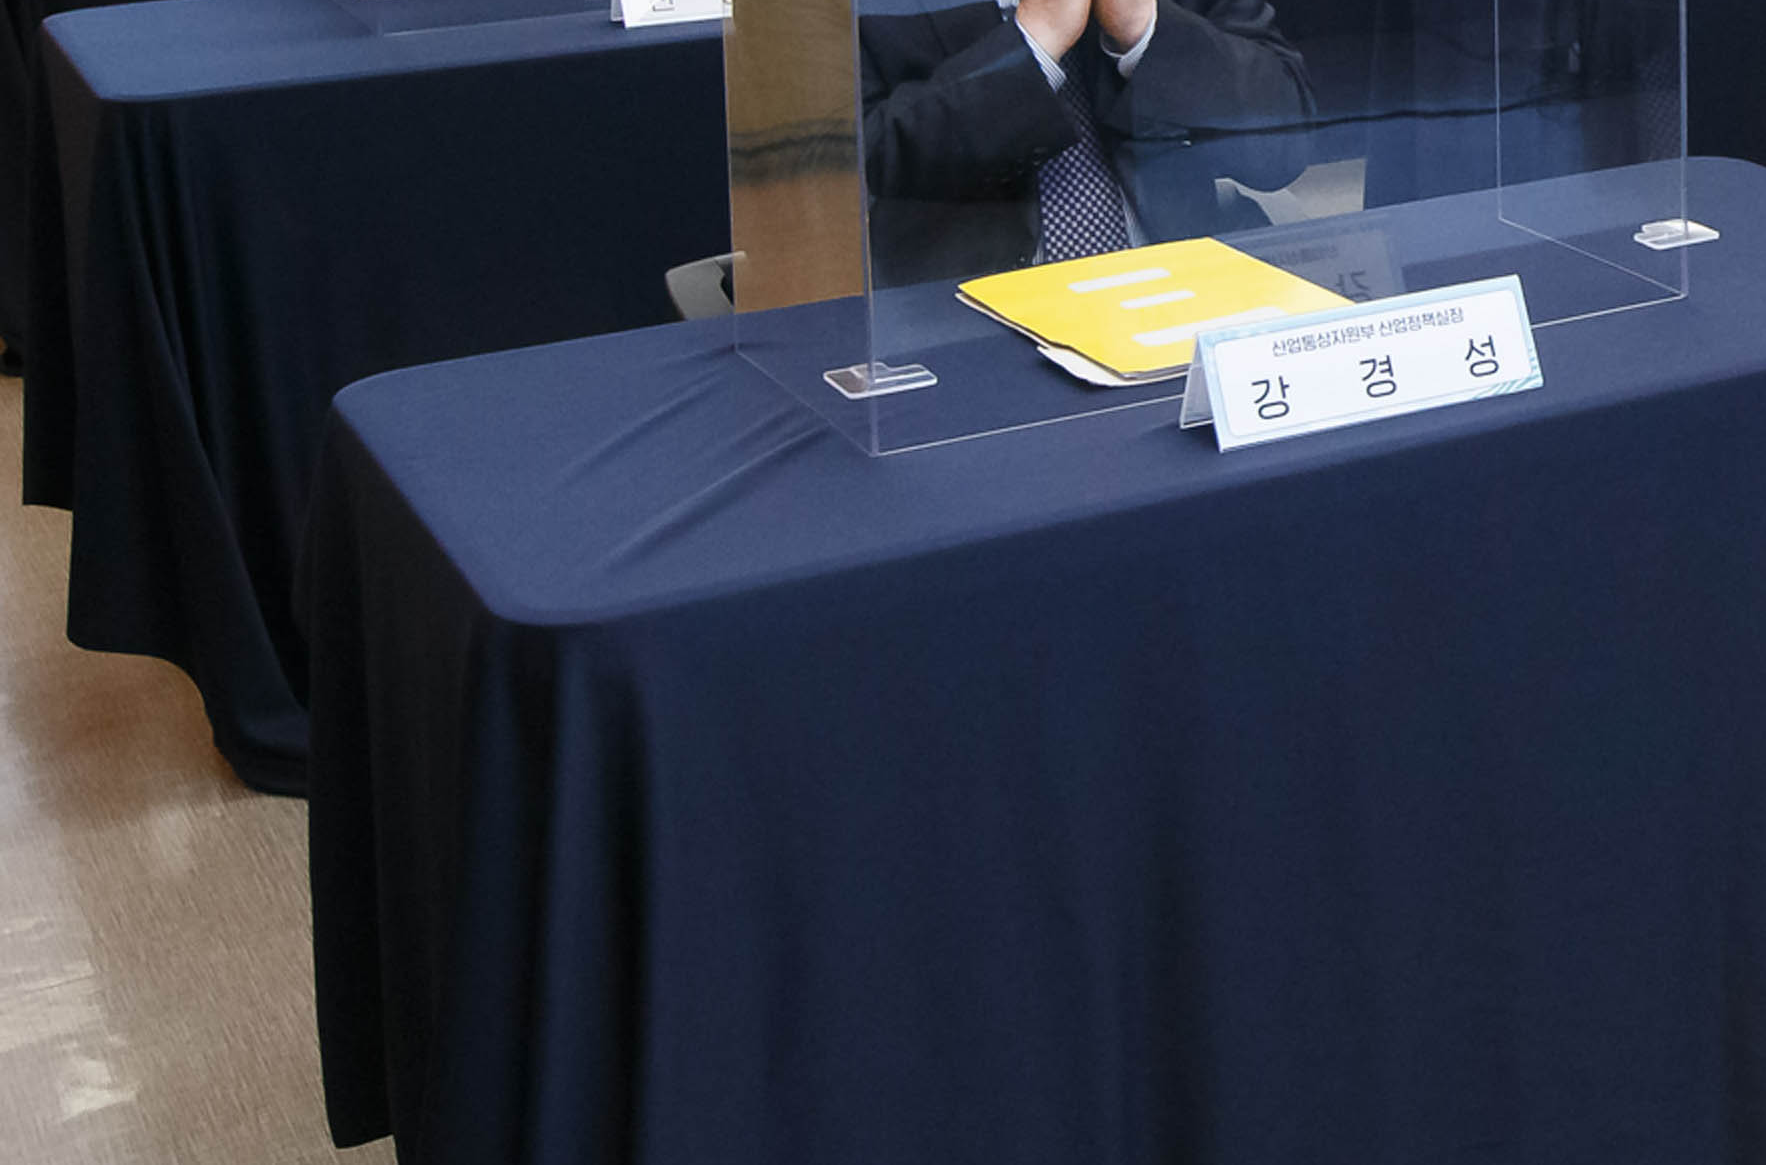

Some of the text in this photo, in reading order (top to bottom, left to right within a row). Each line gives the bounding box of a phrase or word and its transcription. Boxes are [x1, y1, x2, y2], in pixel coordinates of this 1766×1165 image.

[1272, 306, 1464, 357] 산업통상자원부 산업정책실장
[1251, 334, 1500, 421] 강 경 성
